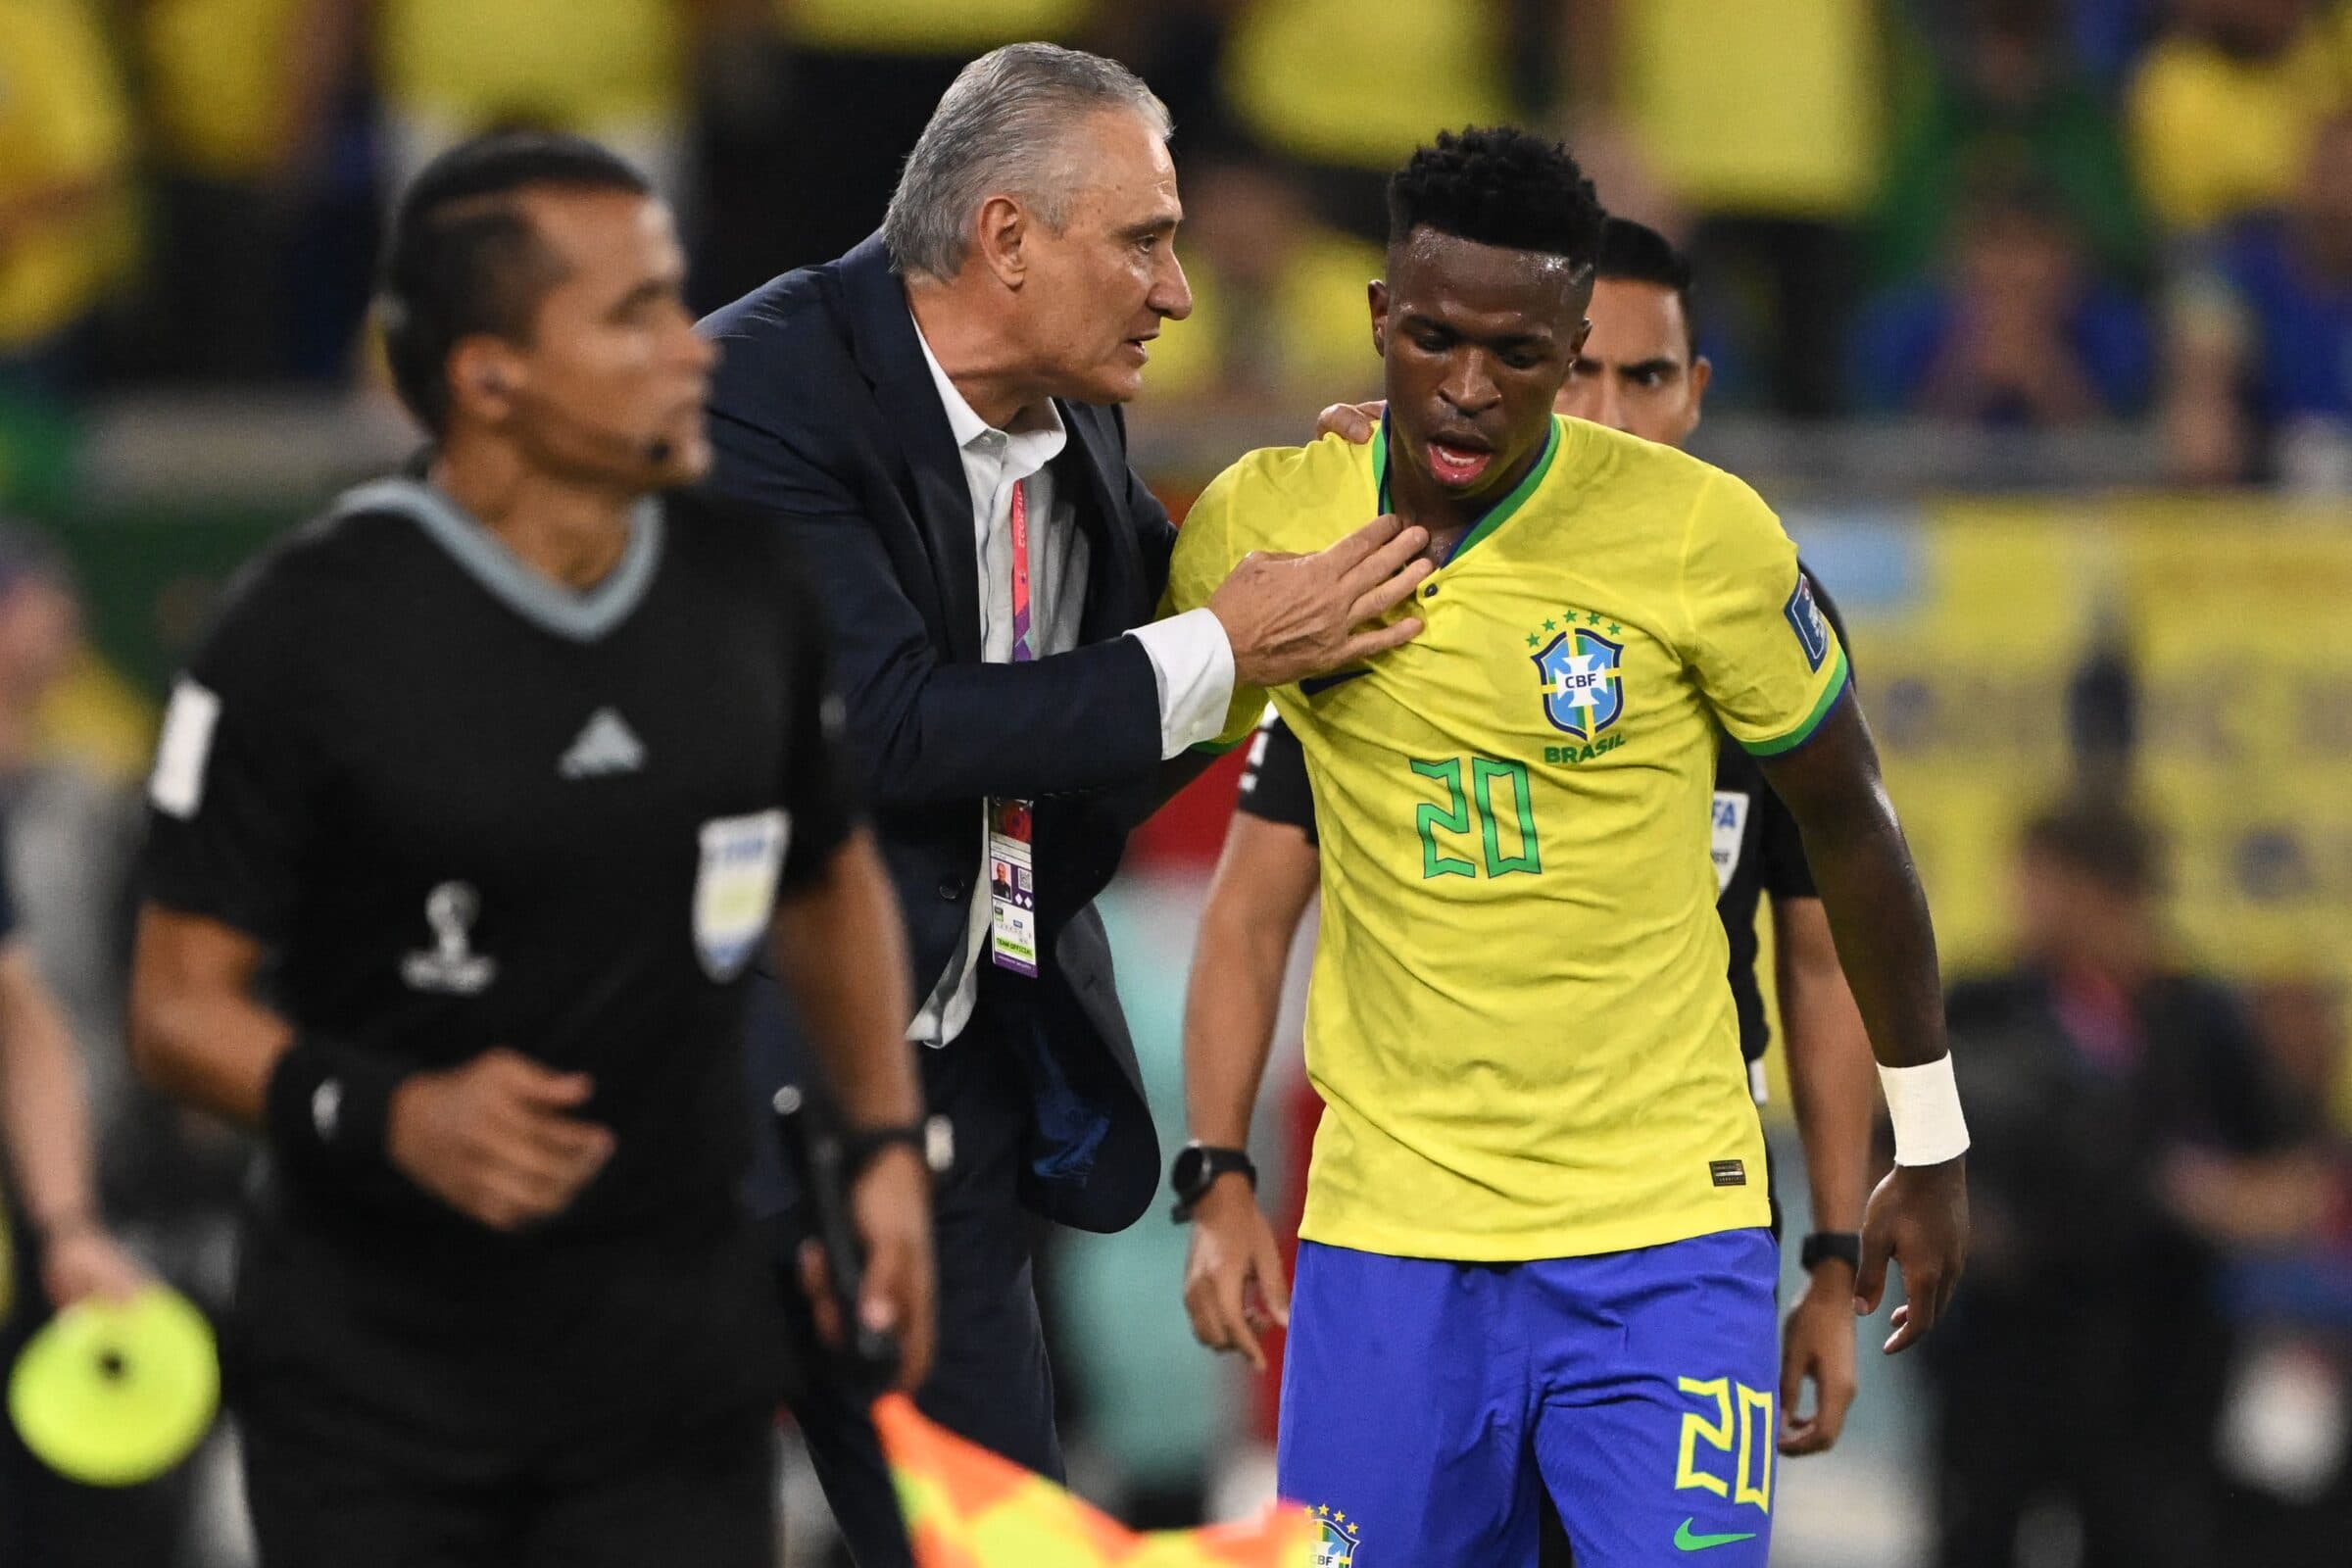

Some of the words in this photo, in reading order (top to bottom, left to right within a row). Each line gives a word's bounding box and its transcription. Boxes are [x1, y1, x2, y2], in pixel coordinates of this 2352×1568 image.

[1564, 672, 1596, 689] CBF
[1544, 734, 1626, 764] BRASIL
[1409, 757, 1542, 879] 20
[1675, 1376, 1773, 1515] 20
